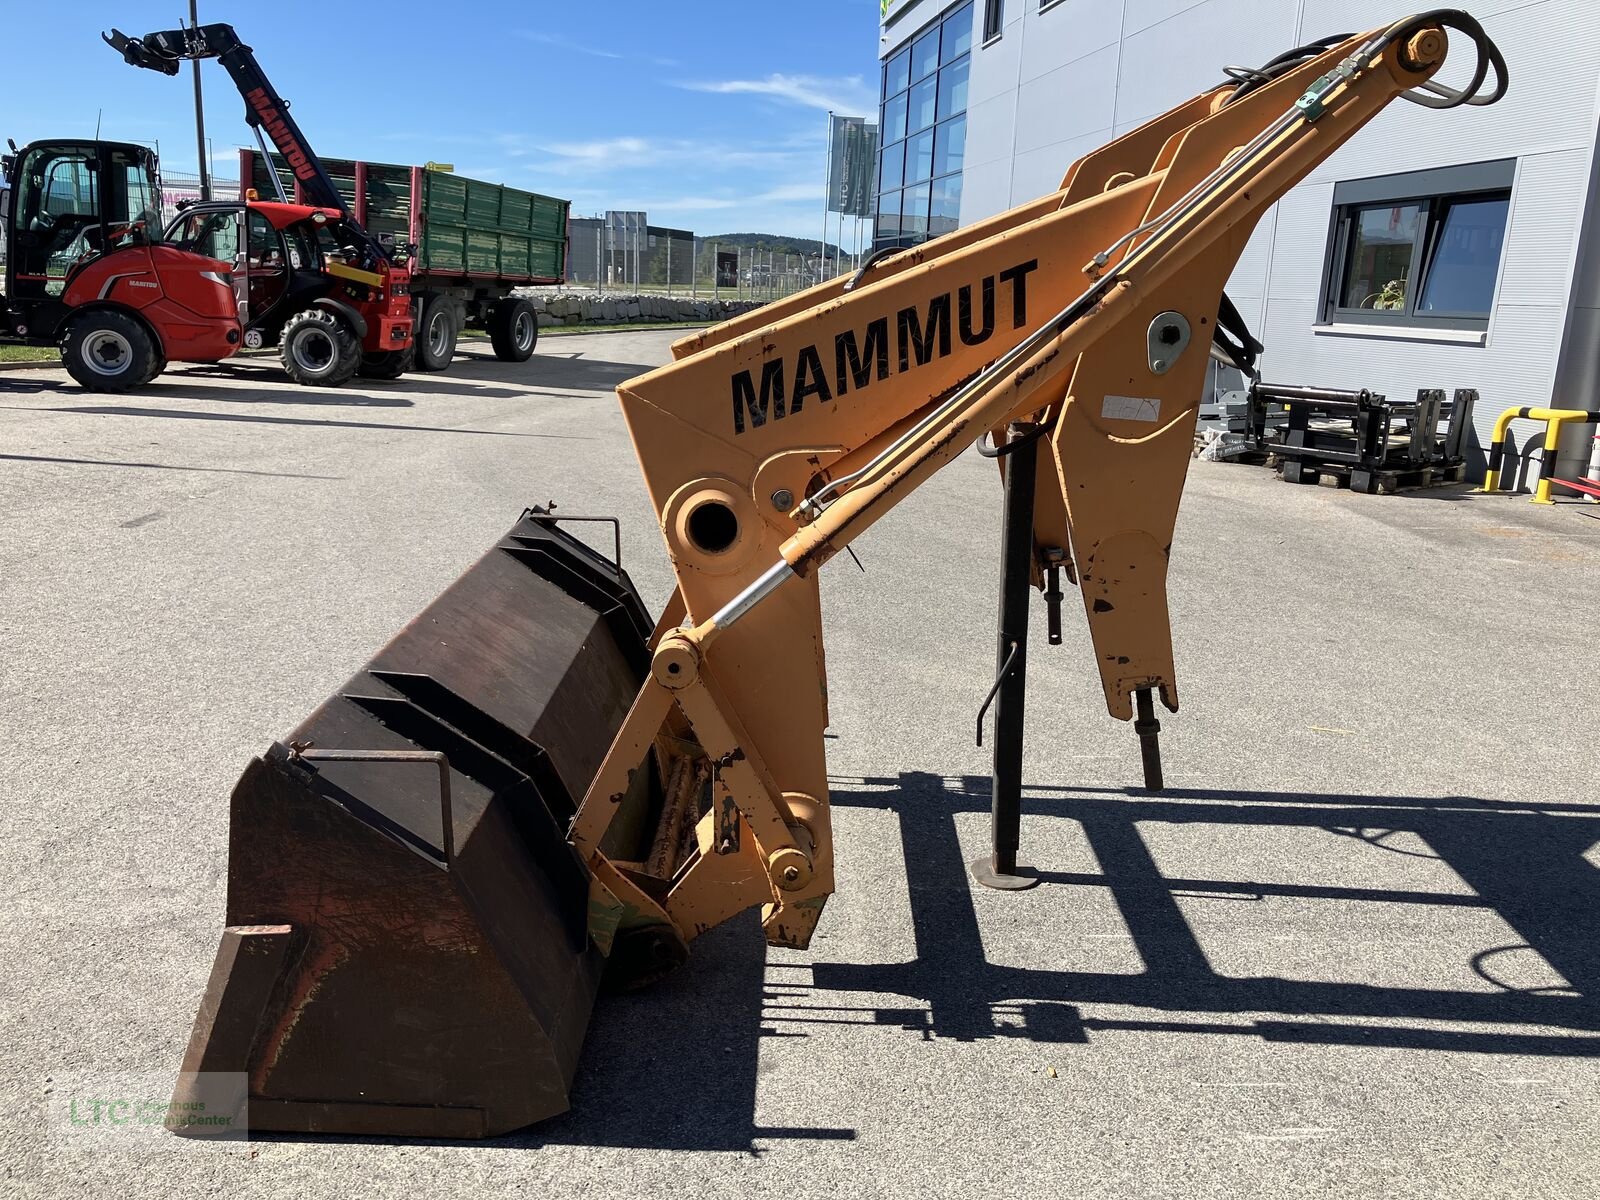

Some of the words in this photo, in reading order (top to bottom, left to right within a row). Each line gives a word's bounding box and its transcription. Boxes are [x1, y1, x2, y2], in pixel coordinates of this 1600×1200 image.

[246, 87, 317, 180] MANITOU
[129, 280, 158, 288] MANITOU
[247, 333, 259, 346] 25
[731, 258, 1039, 435] MAMMUT
